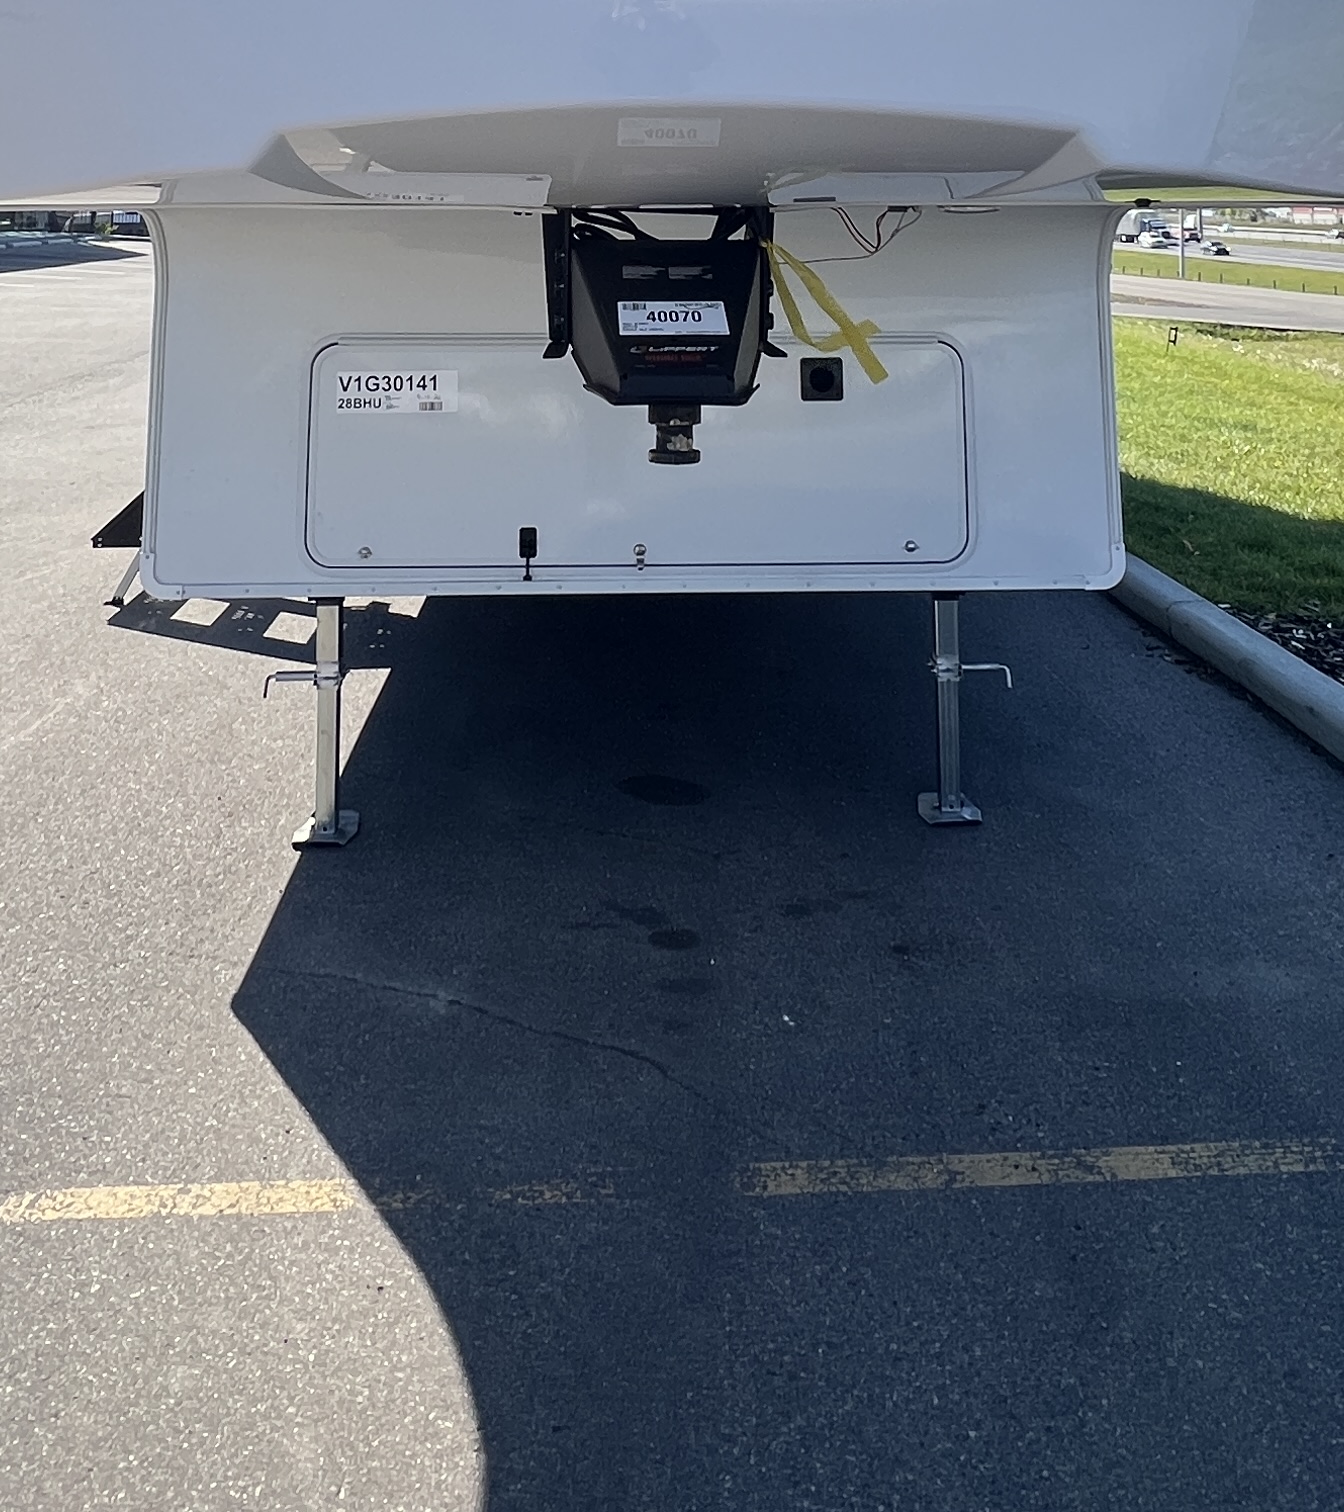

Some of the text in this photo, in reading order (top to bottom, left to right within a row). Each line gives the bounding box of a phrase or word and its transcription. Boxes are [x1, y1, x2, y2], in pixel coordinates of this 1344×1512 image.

[646, 310, 703, 323] 40070
[338, 374, 438, 392] V1G30141
[337, 397, 382, 409] 28BHU
